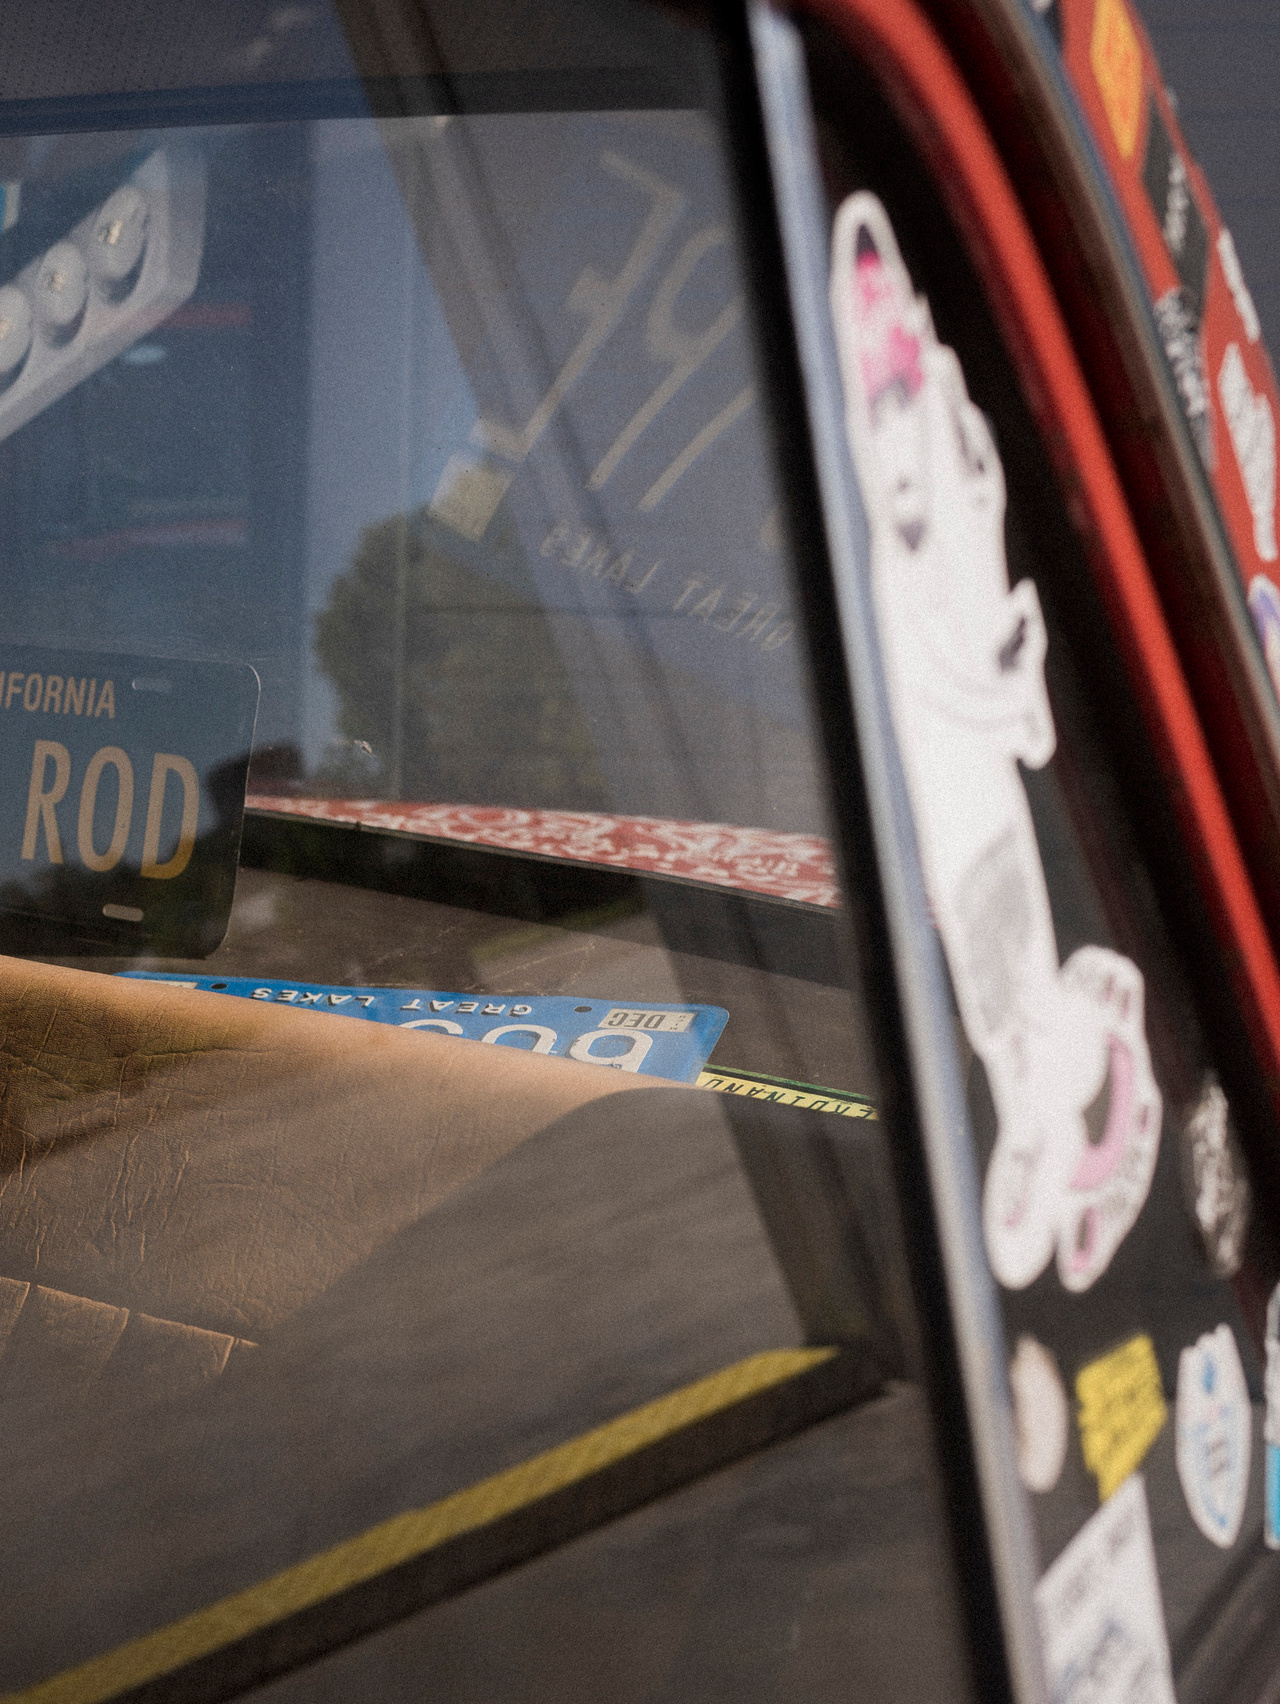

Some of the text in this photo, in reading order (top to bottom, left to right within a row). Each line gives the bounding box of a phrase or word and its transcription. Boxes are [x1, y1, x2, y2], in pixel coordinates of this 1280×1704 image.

[20, 739, 201, 880] ROD
[250, 987, 534, 1017] GREAT LAKES
[607, 1011, 666, 1029] DEC
